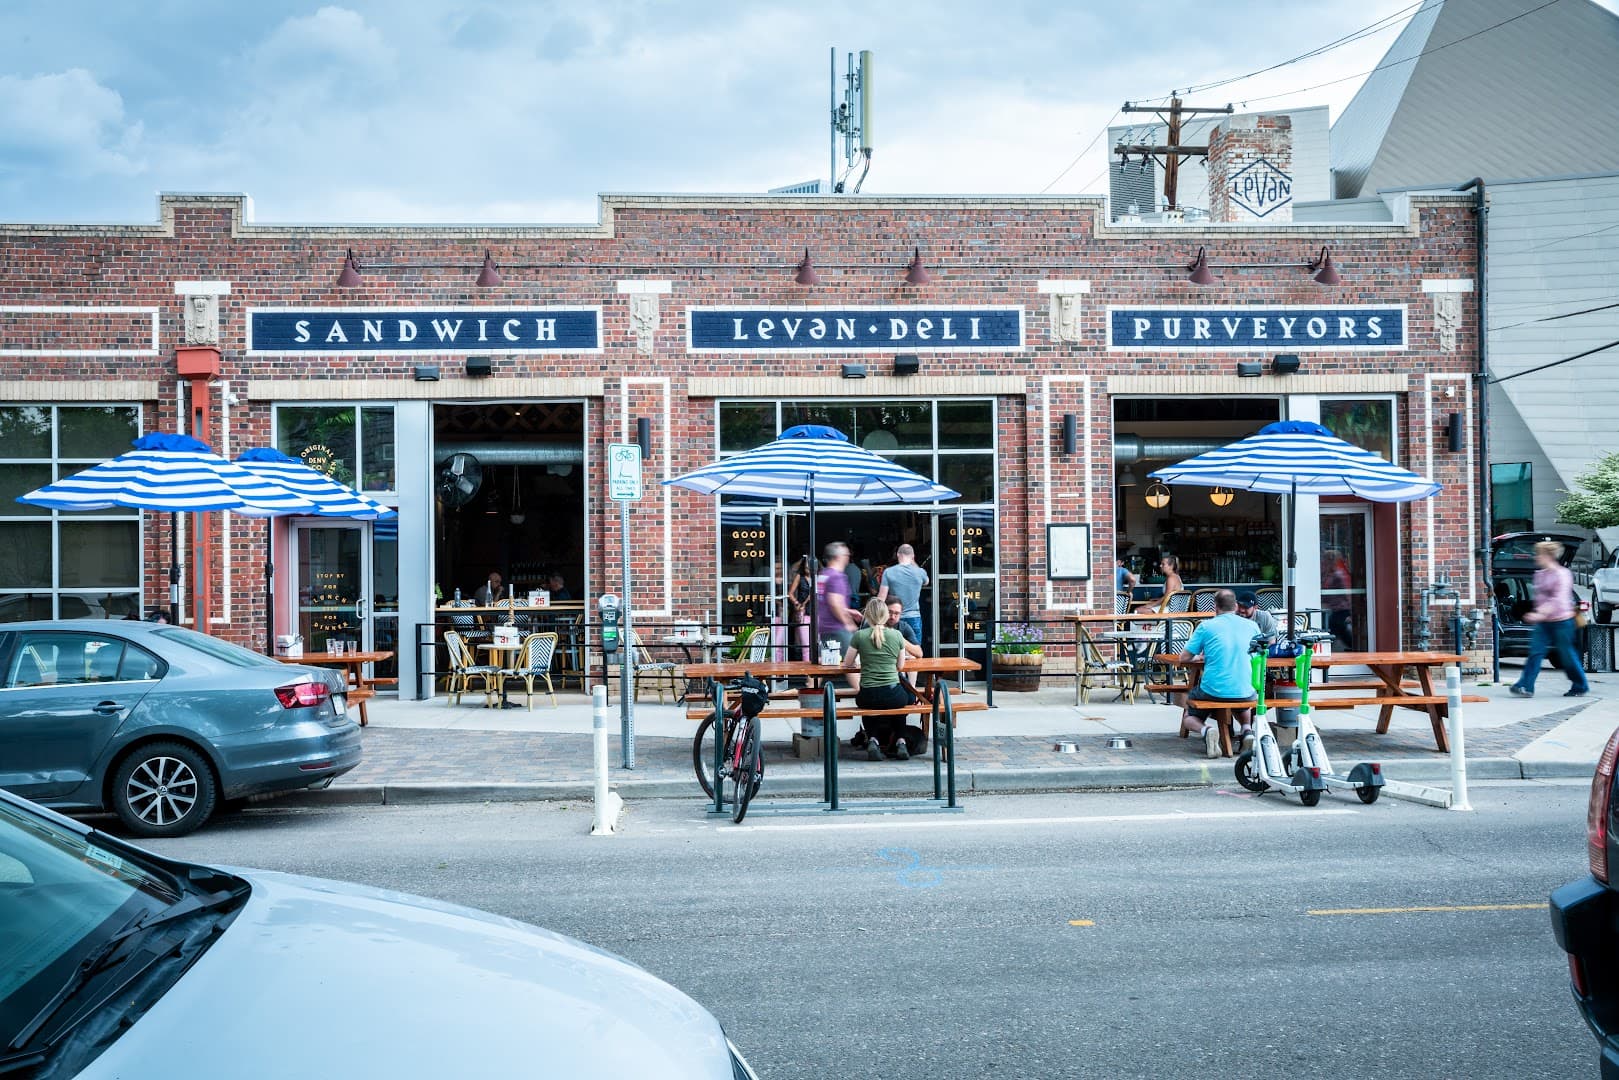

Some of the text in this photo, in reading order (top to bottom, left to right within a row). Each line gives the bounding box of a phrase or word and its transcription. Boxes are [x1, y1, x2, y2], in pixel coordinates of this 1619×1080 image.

[294, 318, 558, 343] SANDWICH
[1133, 316, 1383, 340] PURVEYORS
[301, 445, 334, 458] ORIGINAL
[732, 531, 766, 539] GOOD
[733, 550, 766, 558] FOOD
[951, 547, 983, 555] VBES
[313, 594, 347, 604] LUNCH
[951, 591, 981, 600] WNE
[534, 597, 545, 605] 25
[746, 609, 754, 618] &
[954, 622, 981, 630] DNE
